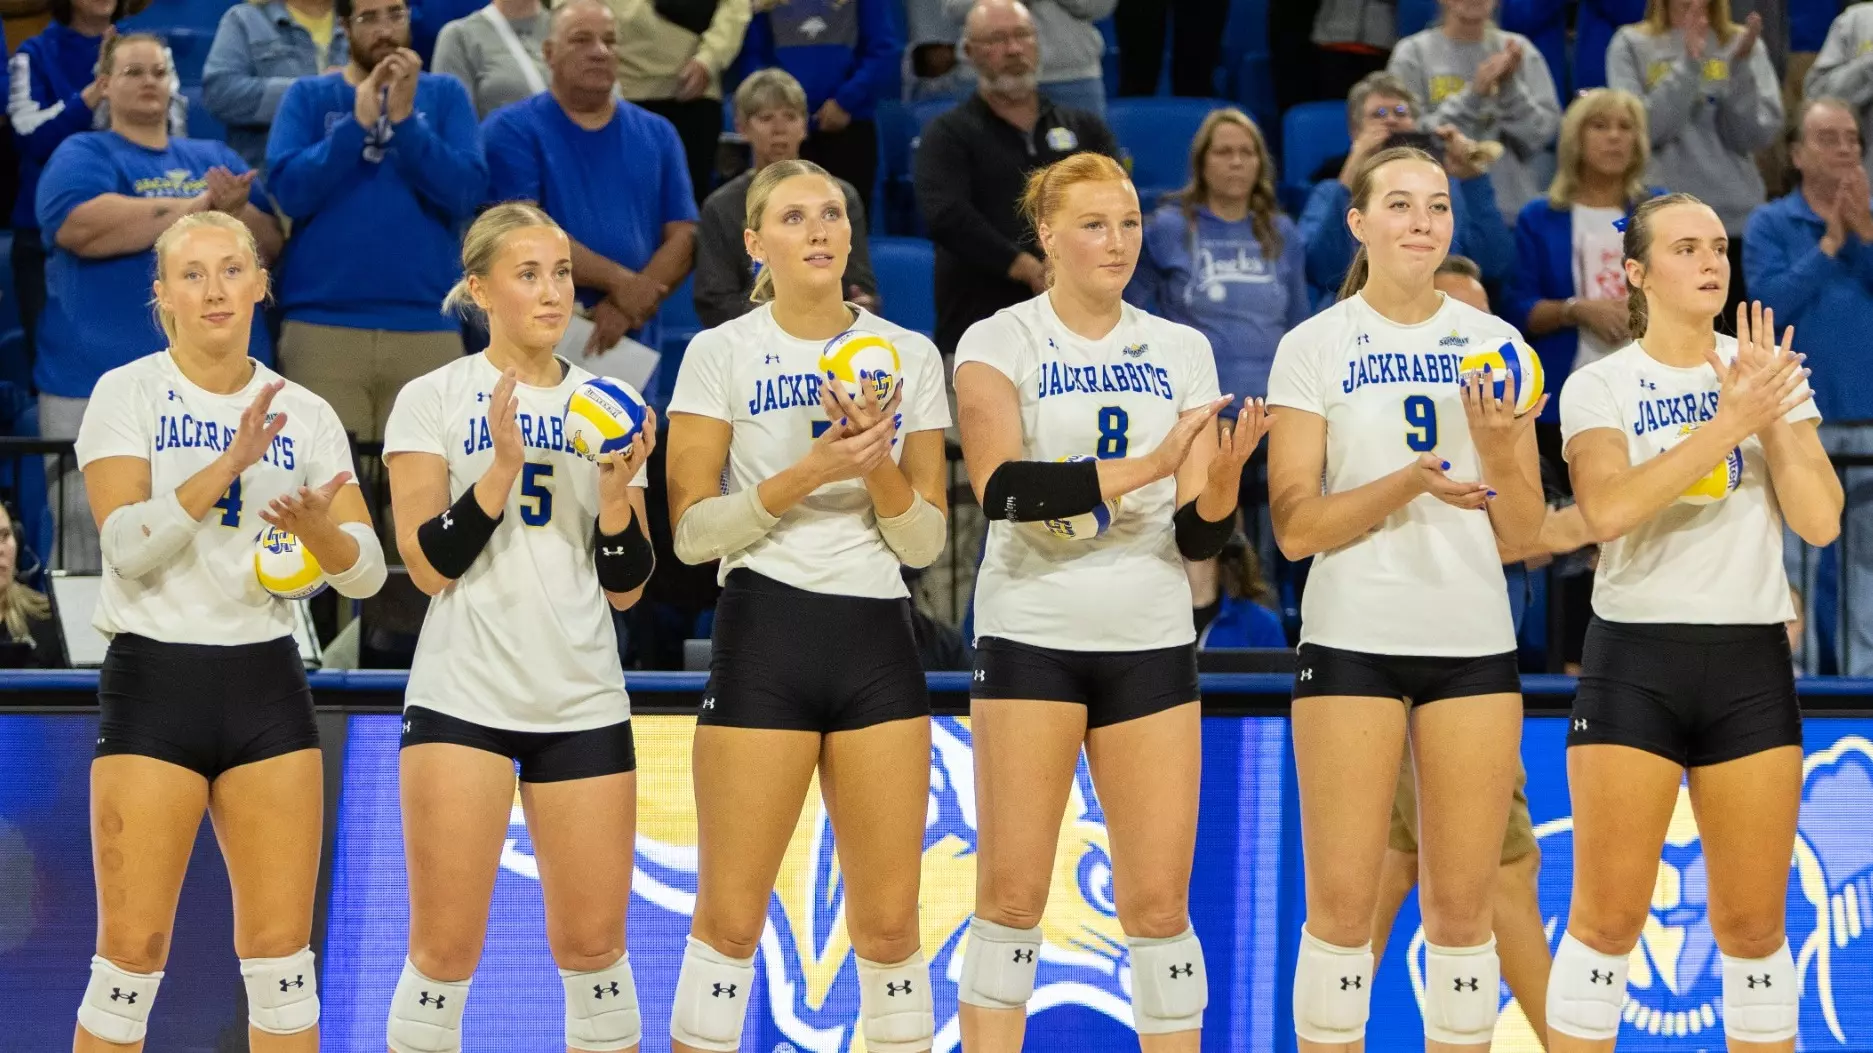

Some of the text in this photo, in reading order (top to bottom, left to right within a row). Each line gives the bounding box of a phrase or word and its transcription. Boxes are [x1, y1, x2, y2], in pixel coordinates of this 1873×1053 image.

[1038, 360, 1173, 401] JACKRABBITS
[1342, 352, 1464, 394] JACKRABBI
[1096, 405, 1130, 460] 8
[1403, 394, 1439, 453] 9
[212, 473, 244, 529] 4
[519, 461, 555, 529] 5
